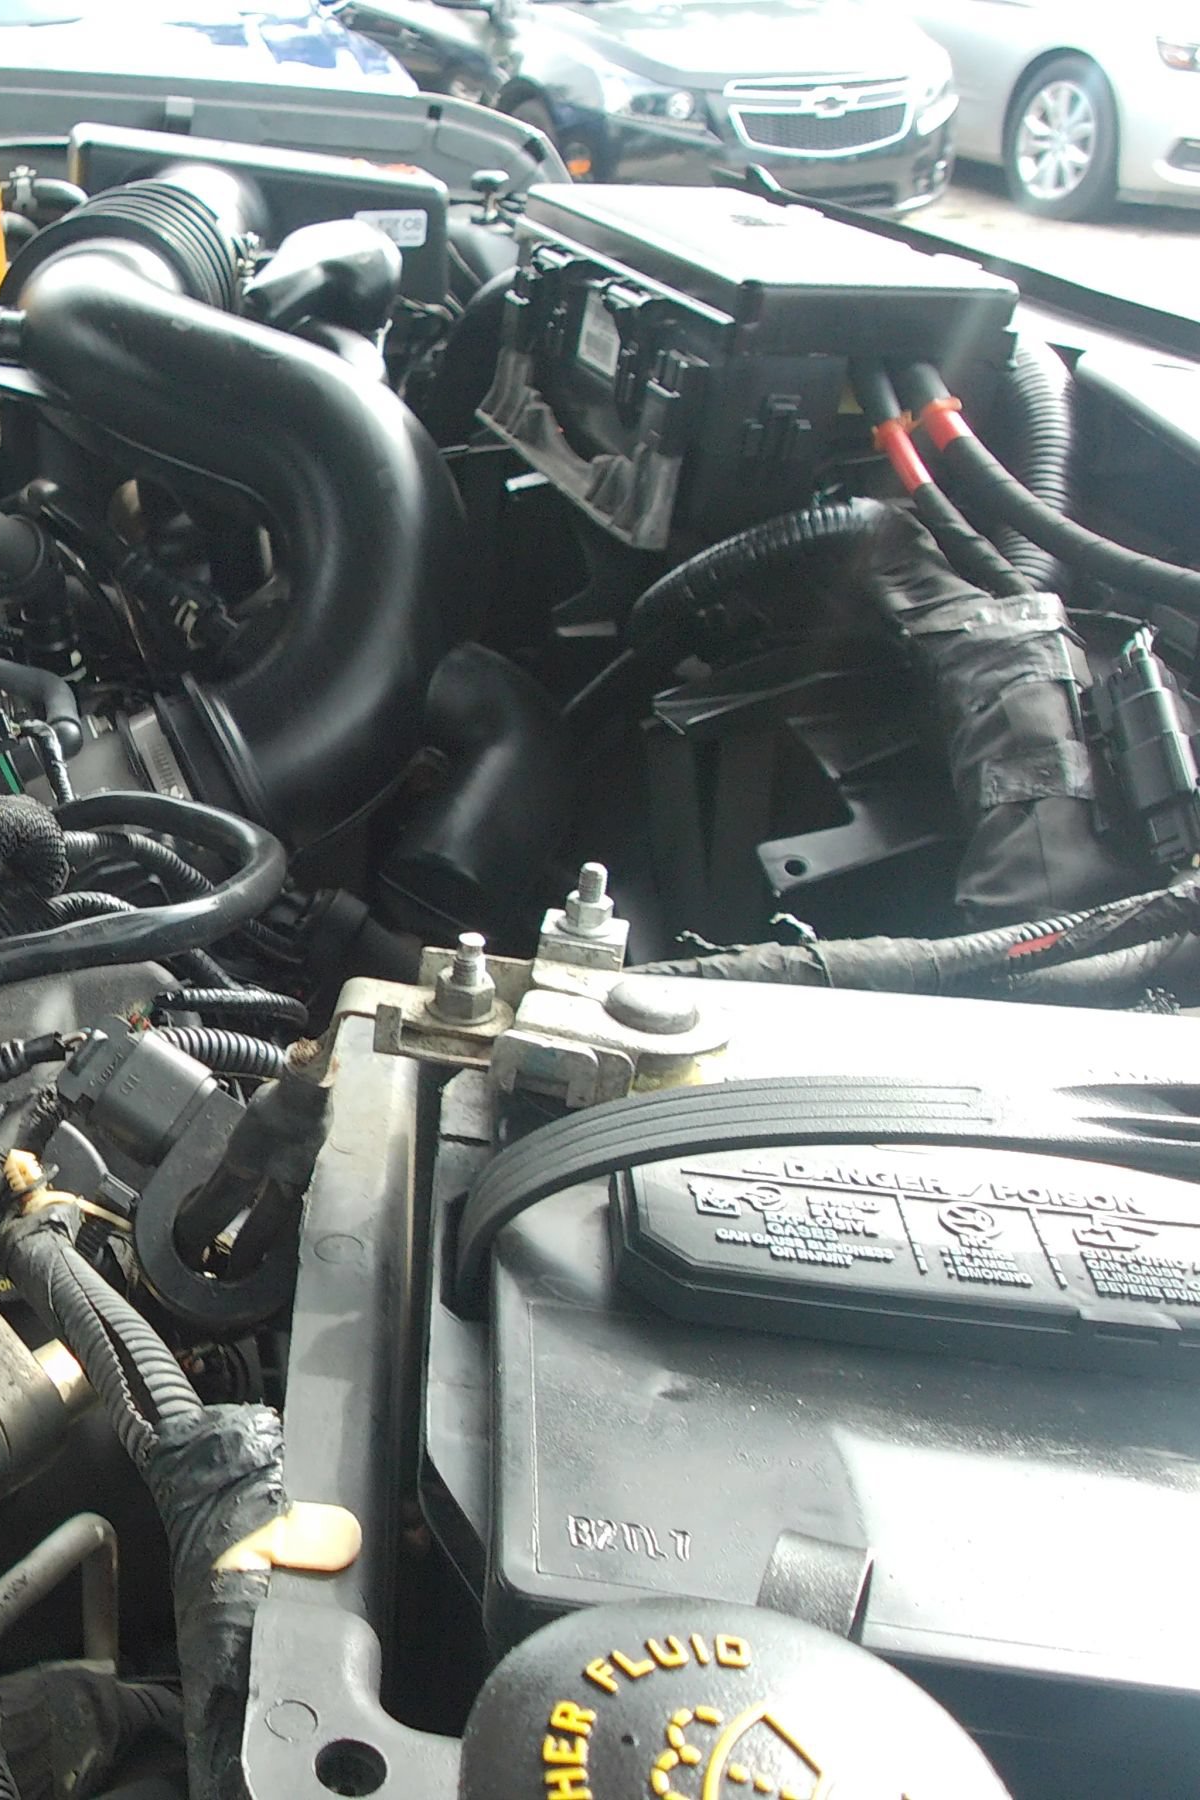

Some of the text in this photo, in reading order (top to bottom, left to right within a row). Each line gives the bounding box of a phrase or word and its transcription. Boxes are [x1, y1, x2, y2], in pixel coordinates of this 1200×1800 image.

[766, 1222, 841, 1242] GASES
[715, 1227, 896, 1261] CAN CAUSE BLINDNESS
[770, 1245, 854, 1268] OR INJURY
[957, 1265, 1034, 1285] SMOKING
[1086, 1258, 1123, 1274] CAN
[1127, 1263, 1185, 1280] CAUSE
[1090, 1268, 1184, 1290] BLINDNESS
[1095, 1280, 1164, 1300] SEVERE
[582, 1632, 752, 1696] FLUID
